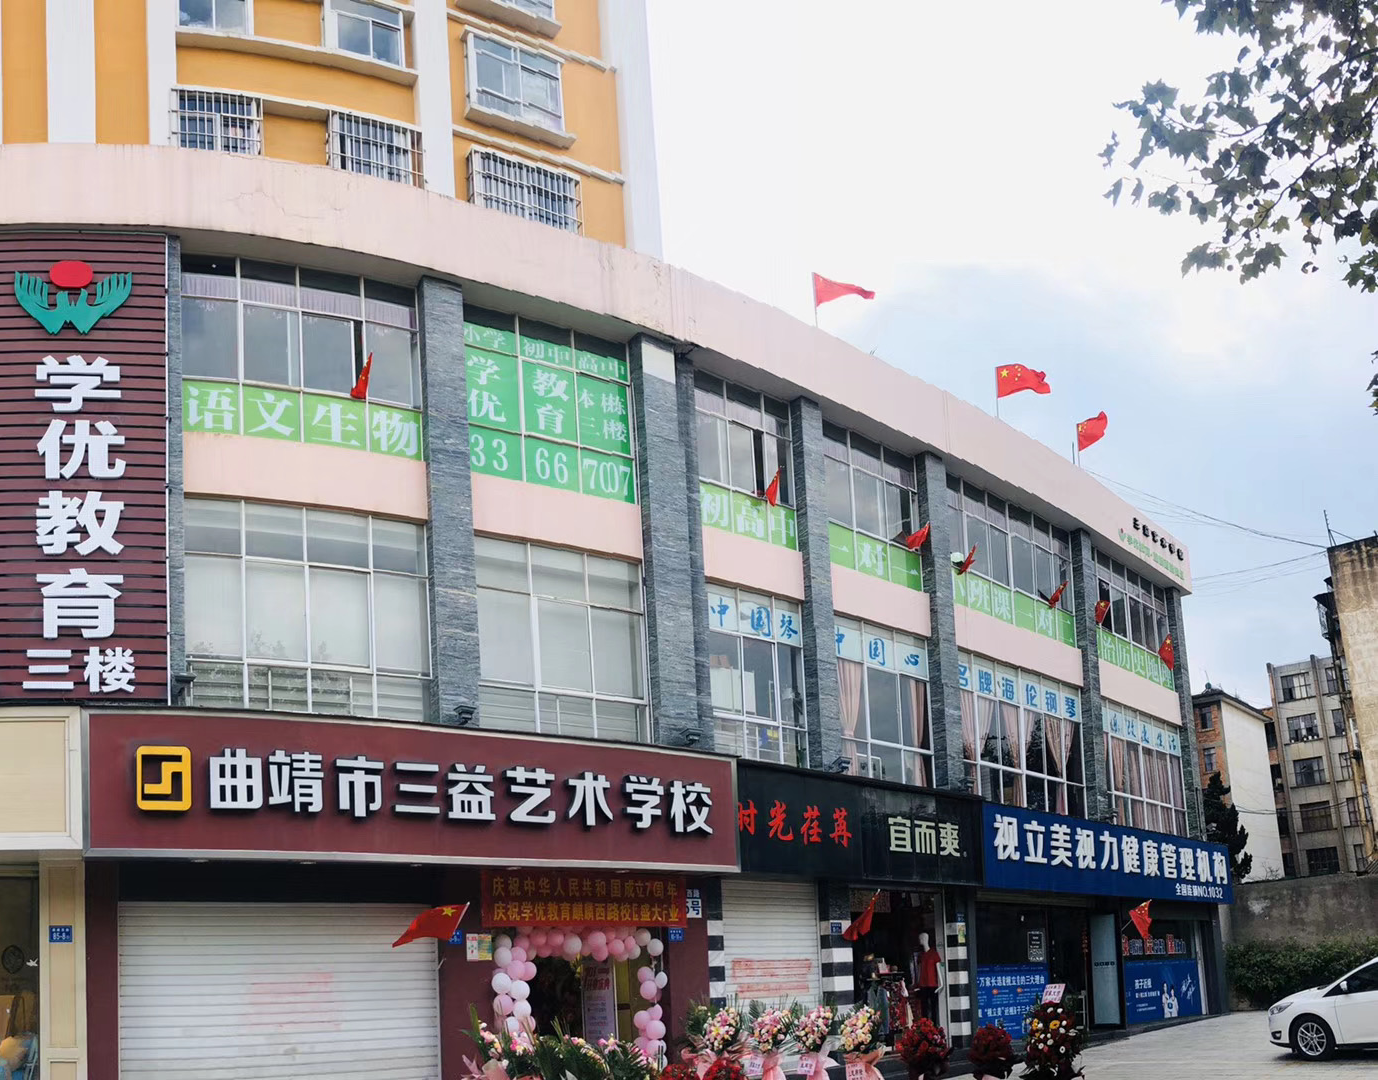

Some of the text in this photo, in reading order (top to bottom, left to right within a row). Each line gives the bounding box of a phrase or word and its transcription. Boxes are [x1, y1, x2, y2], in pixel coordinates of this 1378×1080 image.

[186, 385, 420, 456] 语文生物
[33, 354, 127, 640] 学优教育
[710, 596, 799, 641] 中国琴
[22, 645, 136, 695] 三楼
[834, 626, 920, 668] 中国心
[959, 663, 1076, 719] 名牌海伦钢琴
[207, 747, 714, 835] 曲靖市三益艺术学校
[737, 800, 853, 848] 时光荏苒
[888, 815, 961, 858] 宜而爽
[993, 813, 1229, 885] 视立美视力健康管理机构
